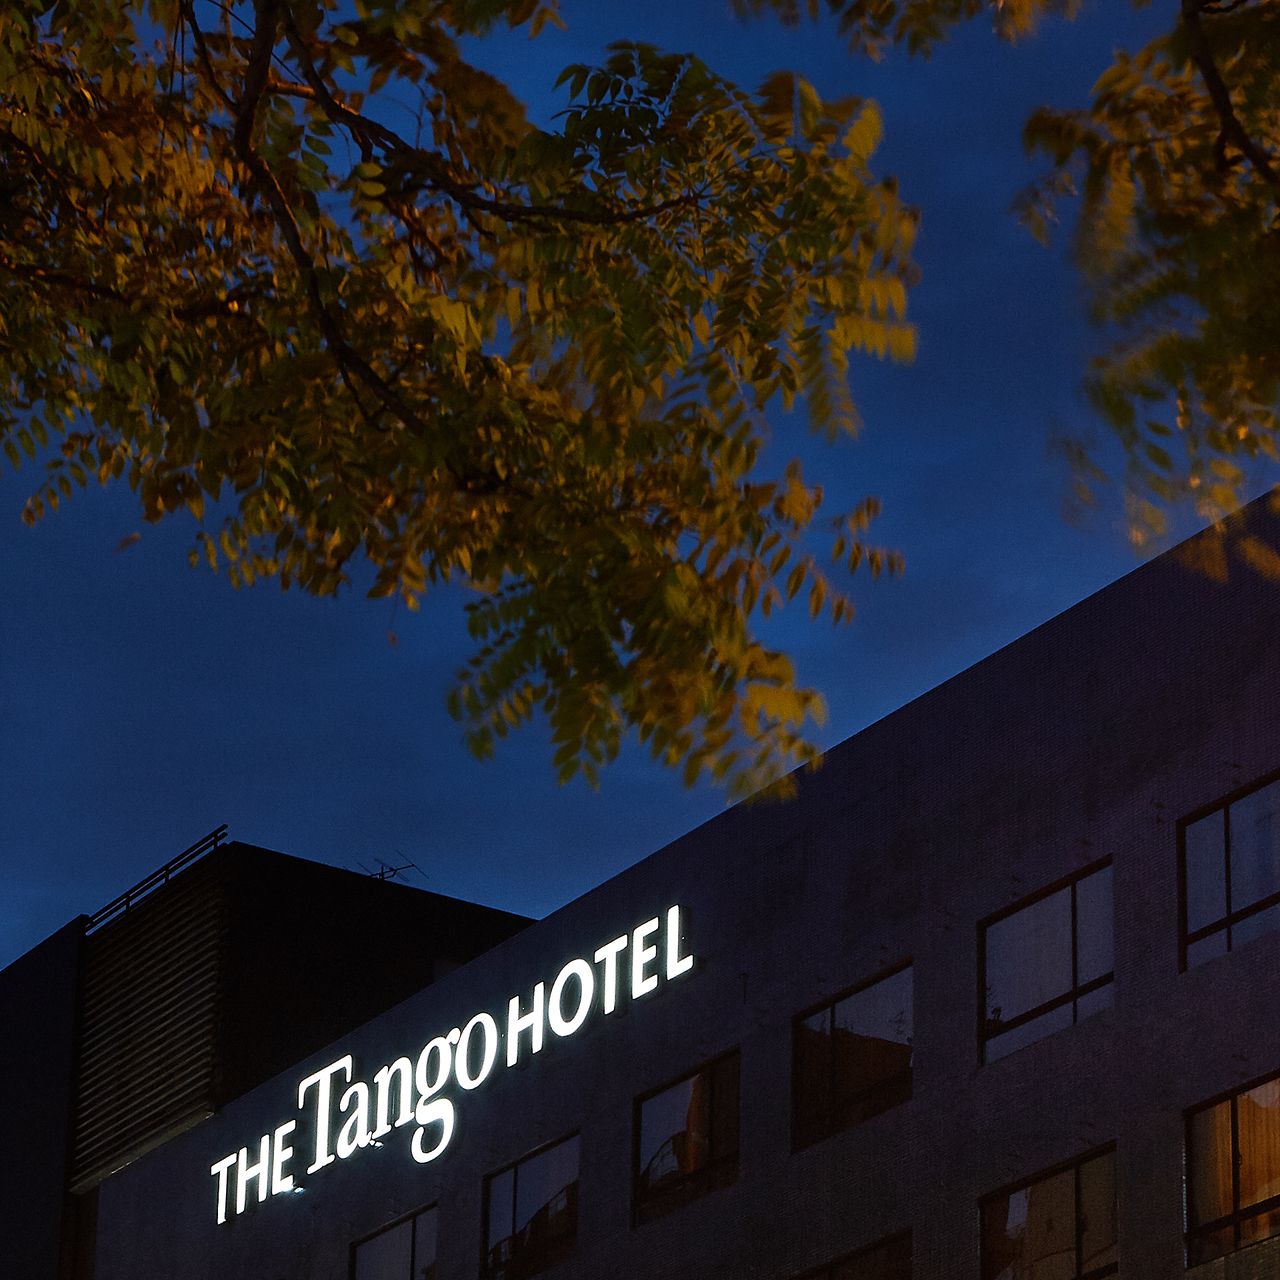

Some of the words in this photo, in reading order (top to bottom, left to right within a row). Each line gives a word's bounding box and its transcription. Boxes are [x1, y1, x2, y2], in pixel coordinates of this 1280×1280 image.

[210, 1119, 297, 1225] THE
[298, 1012, 498, 1175] Tango
[506, 904, 695, 1067] HOTEL
